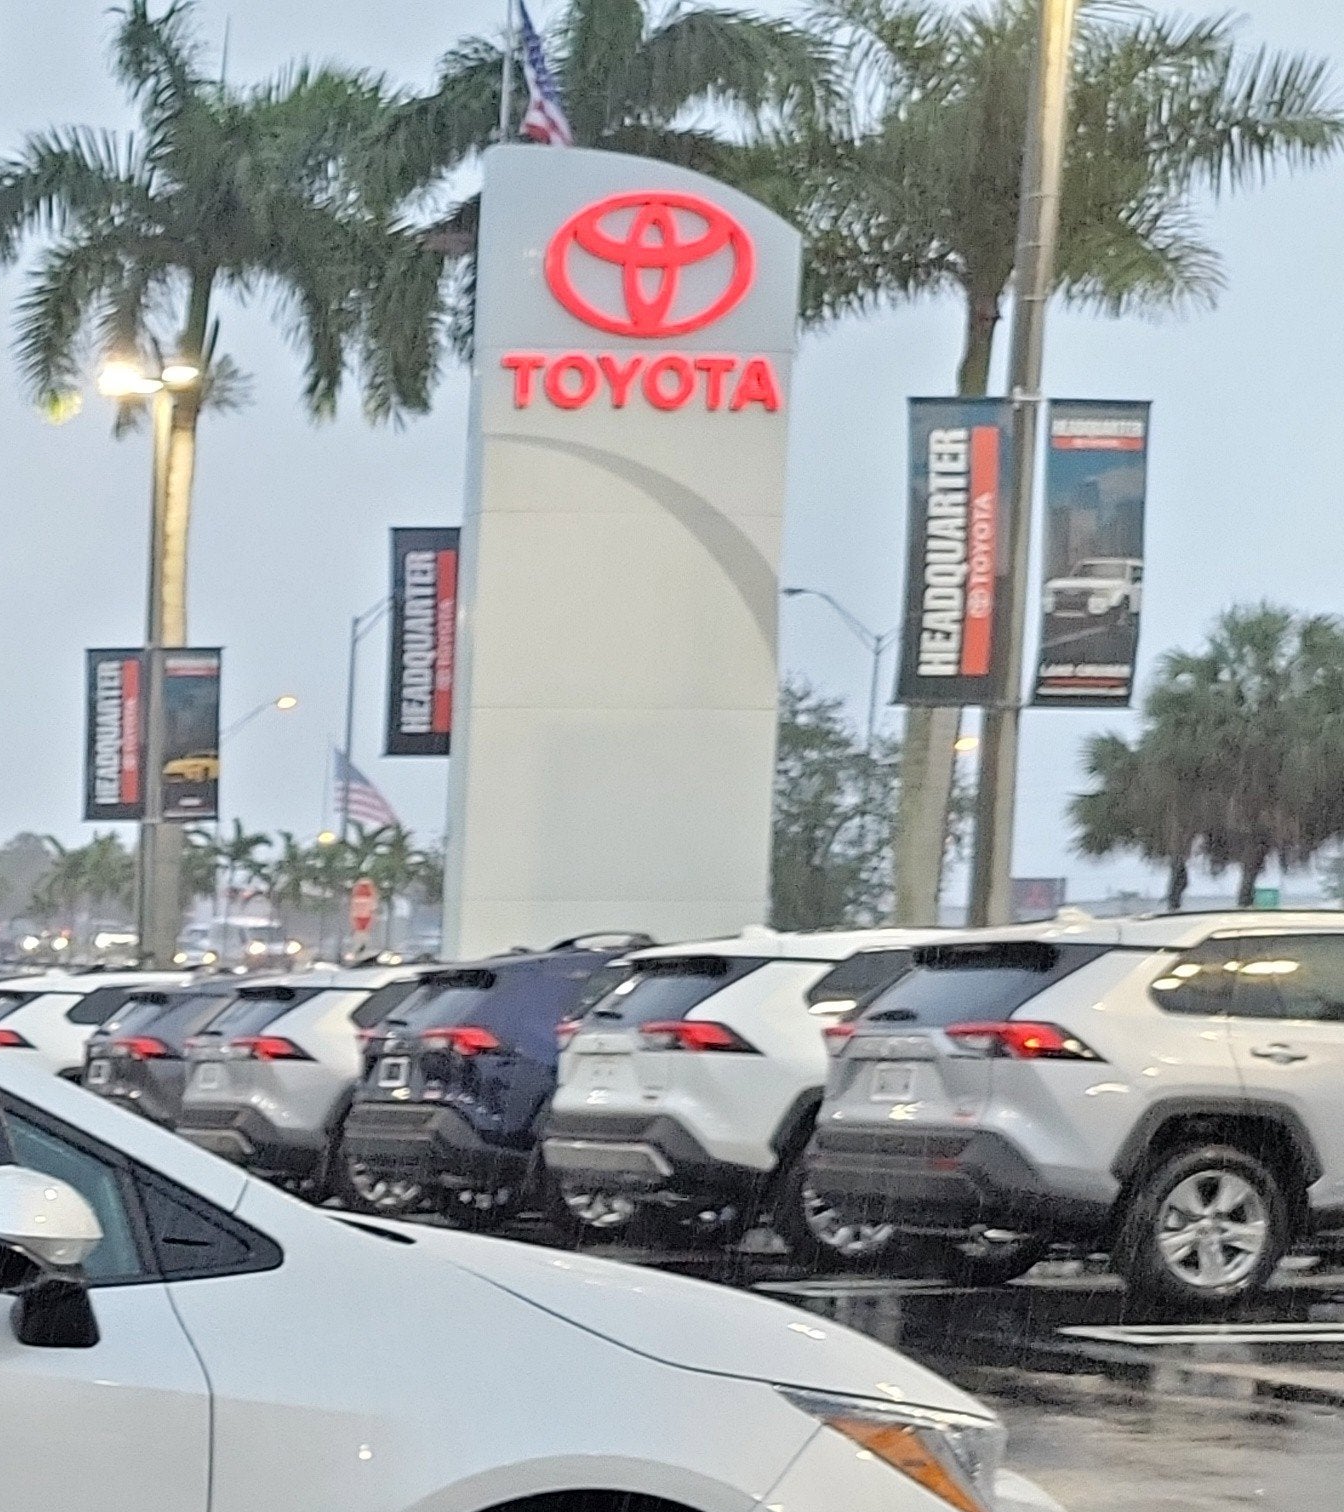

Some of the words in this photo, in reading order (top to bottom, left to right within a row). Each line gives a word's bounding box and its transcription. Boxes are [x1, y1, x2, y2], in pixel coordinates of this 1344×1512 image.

[500, 355, 782, 412] TOYOTA
[400, 551, 437, 734] HEADQUARTER
[917, 428, 970, 677] HEADQUARTER
